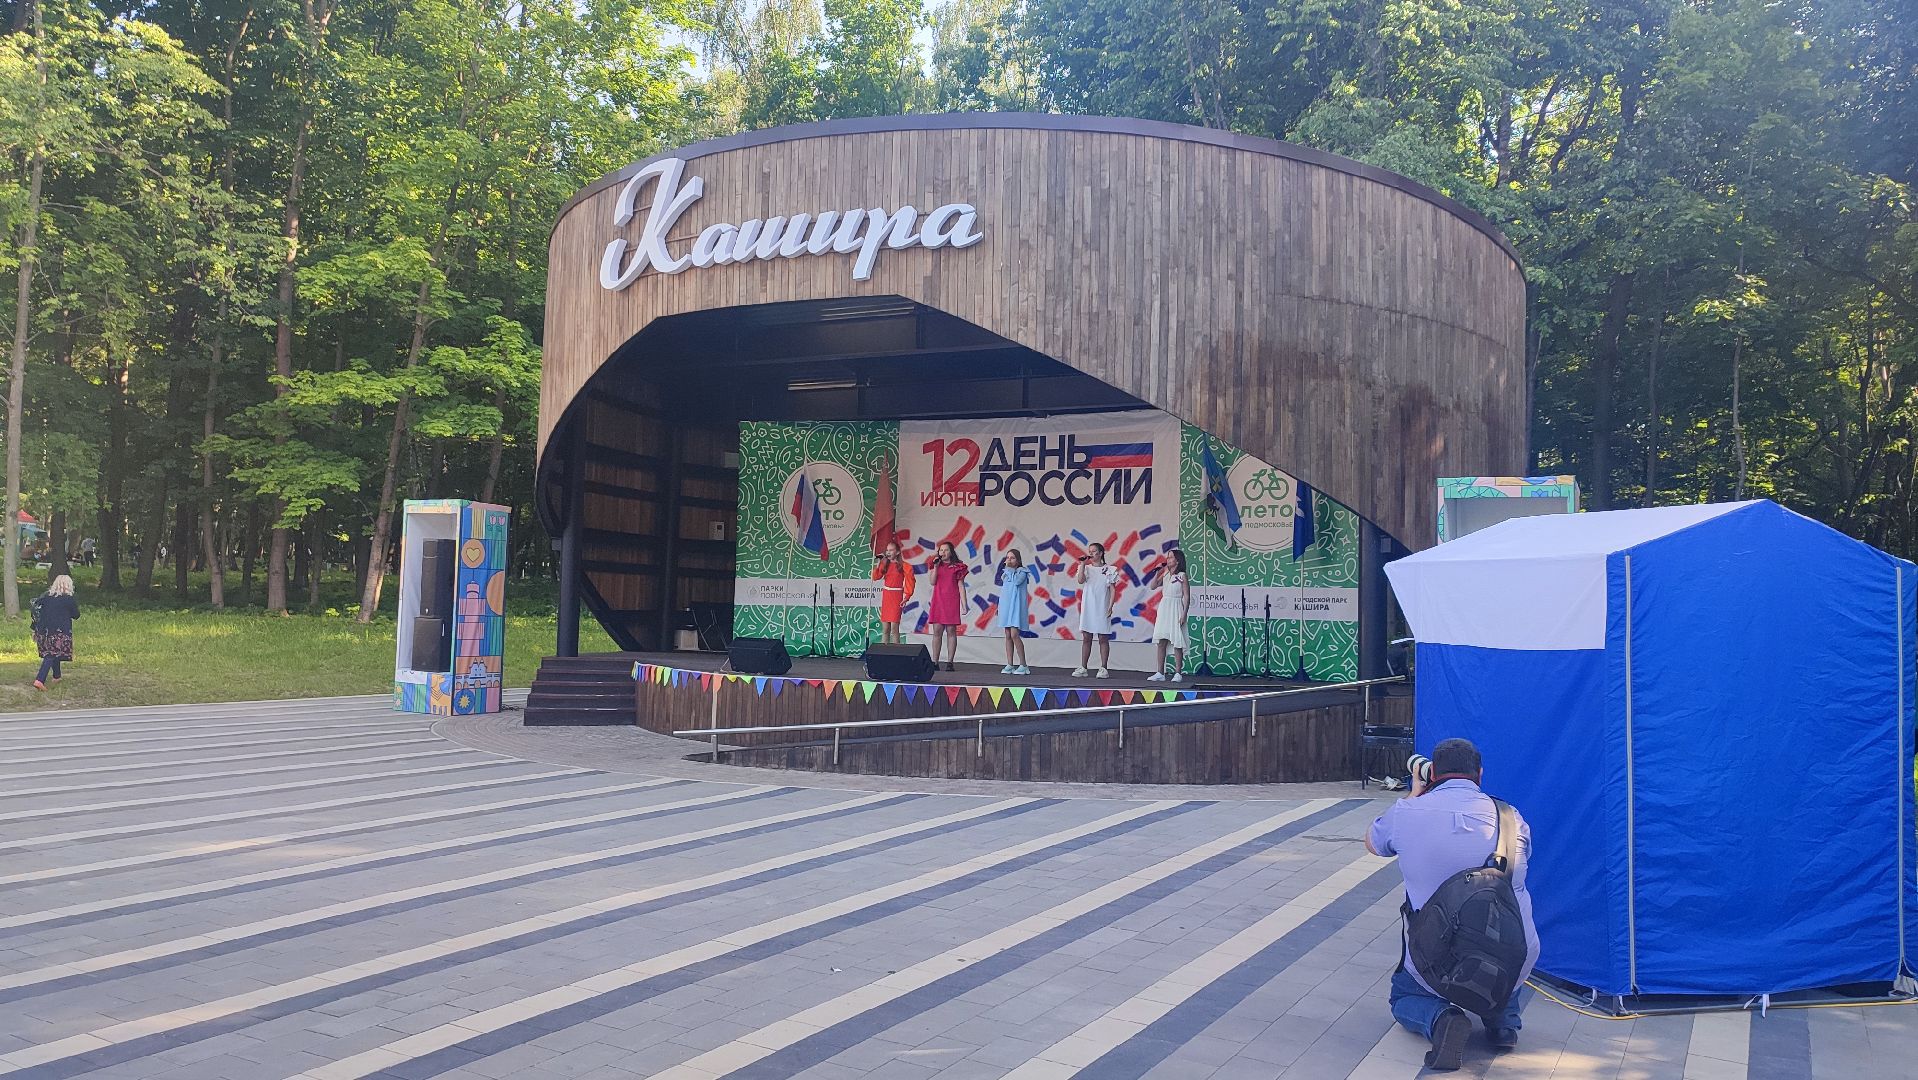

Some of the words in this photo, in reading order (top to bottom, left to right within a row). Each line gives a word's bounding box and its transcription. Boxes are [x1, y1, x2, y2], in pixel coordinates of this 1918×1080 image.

[600, 157, 984, 292] Кашира
[922, 438, 981, 494] 12
[978, 434, 1094, 471] ДЕНЬ
[921, 491, 978, 507] ИЮНЯ
[978, 468, 1153, 507] РОССИИ
[1240, 504, 1294, 518] лето
[1244, 521, 1294, 529] ПОДМОСКОВЬЕ
